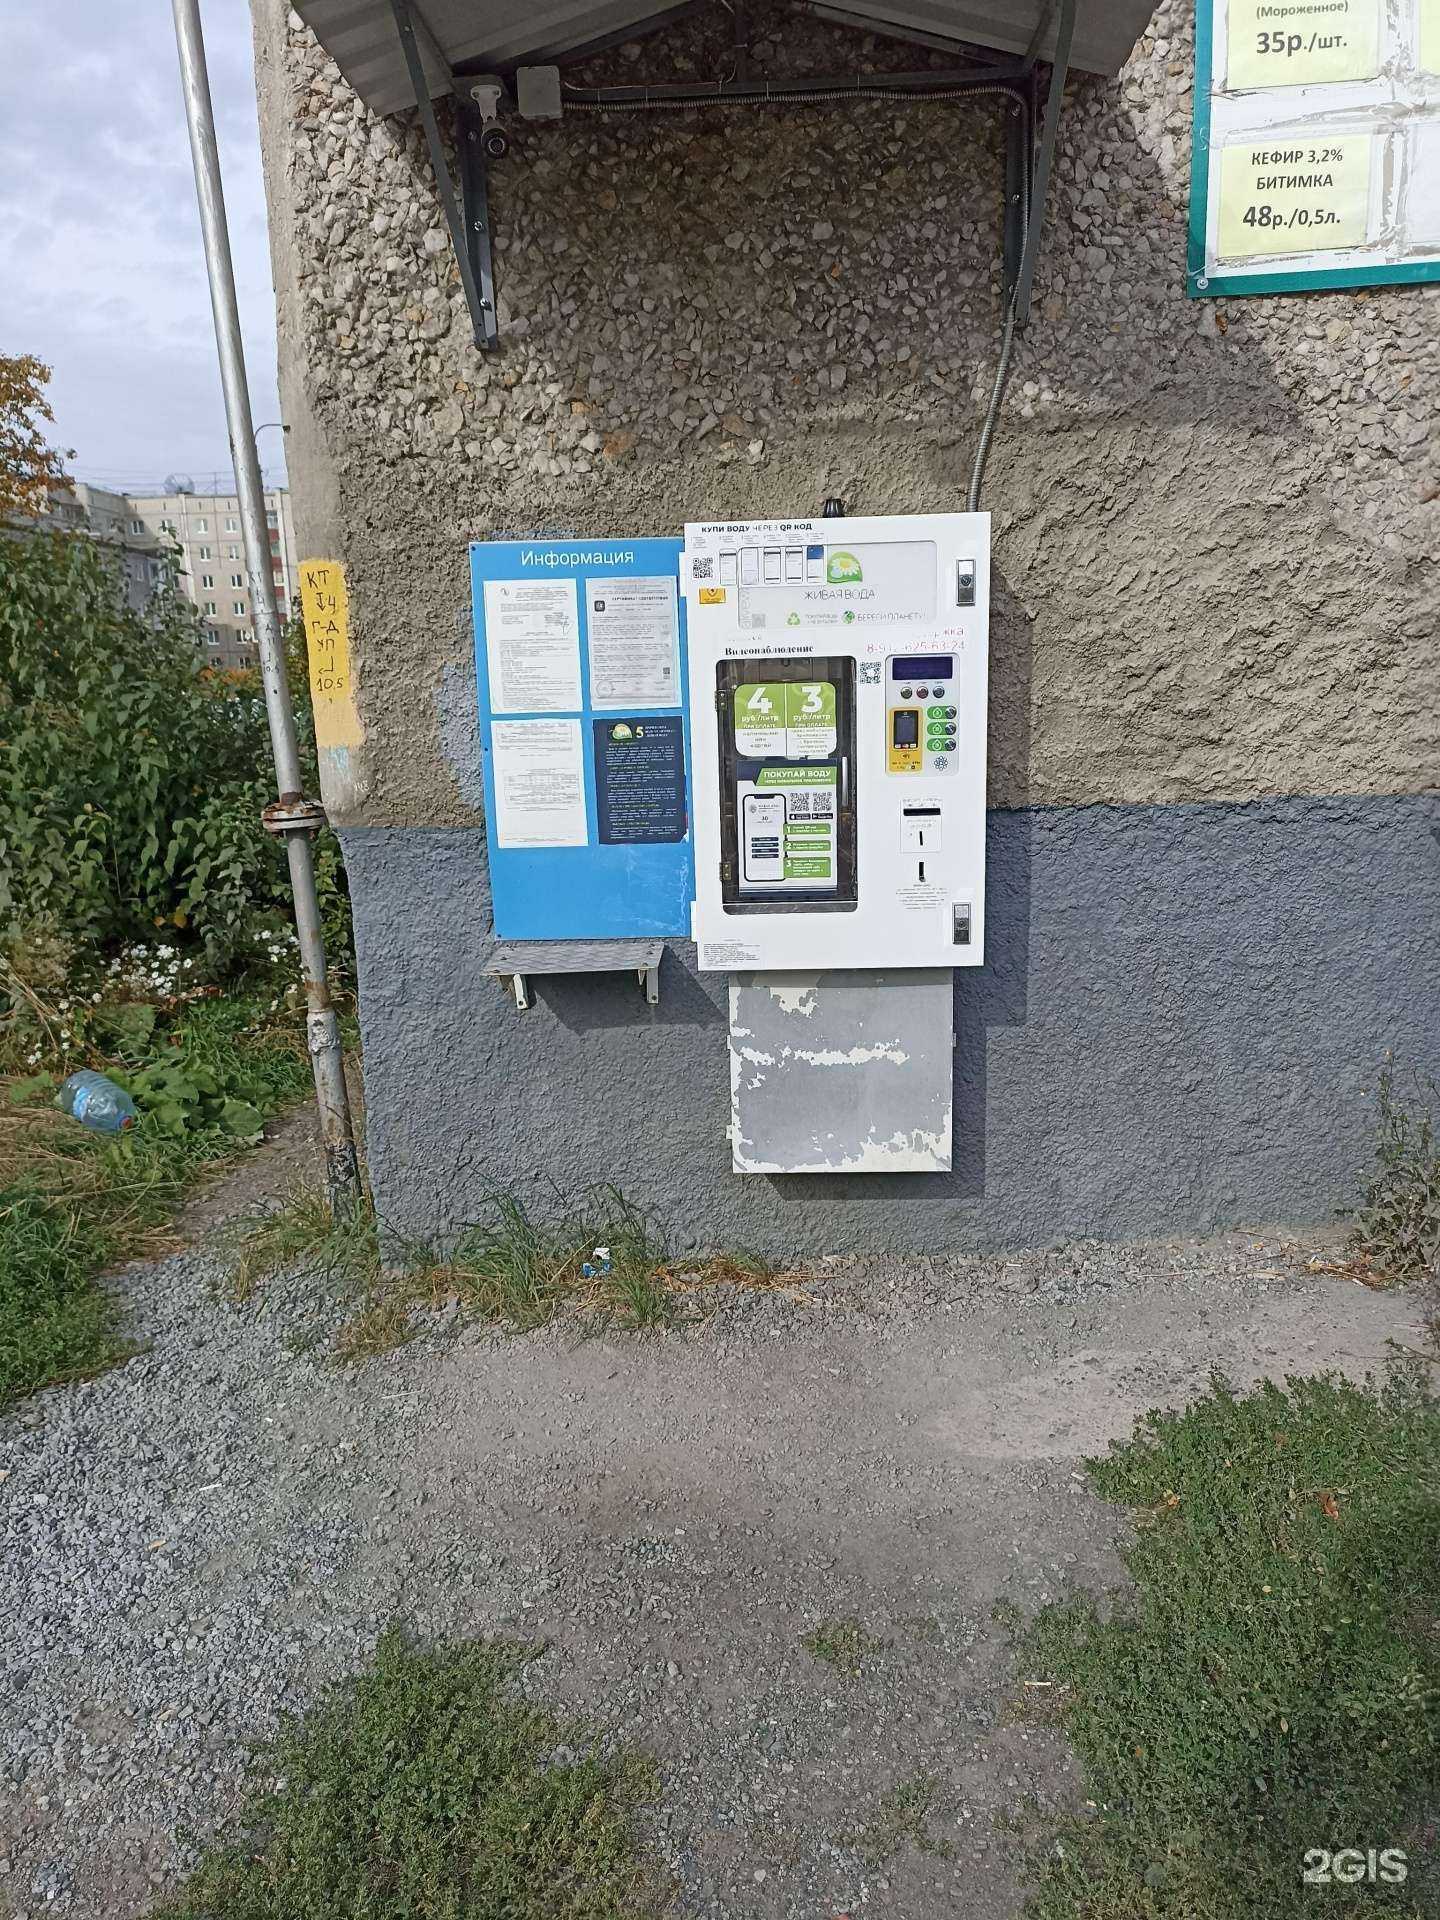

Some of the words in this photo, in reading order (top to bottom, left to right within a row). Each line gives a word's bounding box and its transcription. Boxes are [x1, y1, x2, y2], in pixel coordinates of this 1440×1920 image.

[1256, 0, 1348, 20] (Мороженное)
[1256, 31, 1347, 57] 35р./шт.
[1252, 150, 1304, 165] КЕФИР
[1307, 149, 1343, 164] 3,2%
[1256, 174, 1334, 190] БИТИМКА
[1242, 205, 1341, 230] 48р./0,5л.
[702, 525, 725, 533] КУПИ
[727, 524, 750, 532] ВОДУ
[780, 524, 792, 532] QR
[521, 550, 635, 568] Информация
[307, 570, 330, 589] КТ
[805, 589, 843, 600] ЖИВАЯ
[845, 588, 876, 600] ВОДА
[747, 686, 773, 713] 4
[801, 685, 823, 713] 3
[793, 713, 831, 721] руб./литр
[635, 726, 644, 738] 5
[764, 770, 806, 778] ПОКУПАЙ
[786, 860, 792, 868] 3
